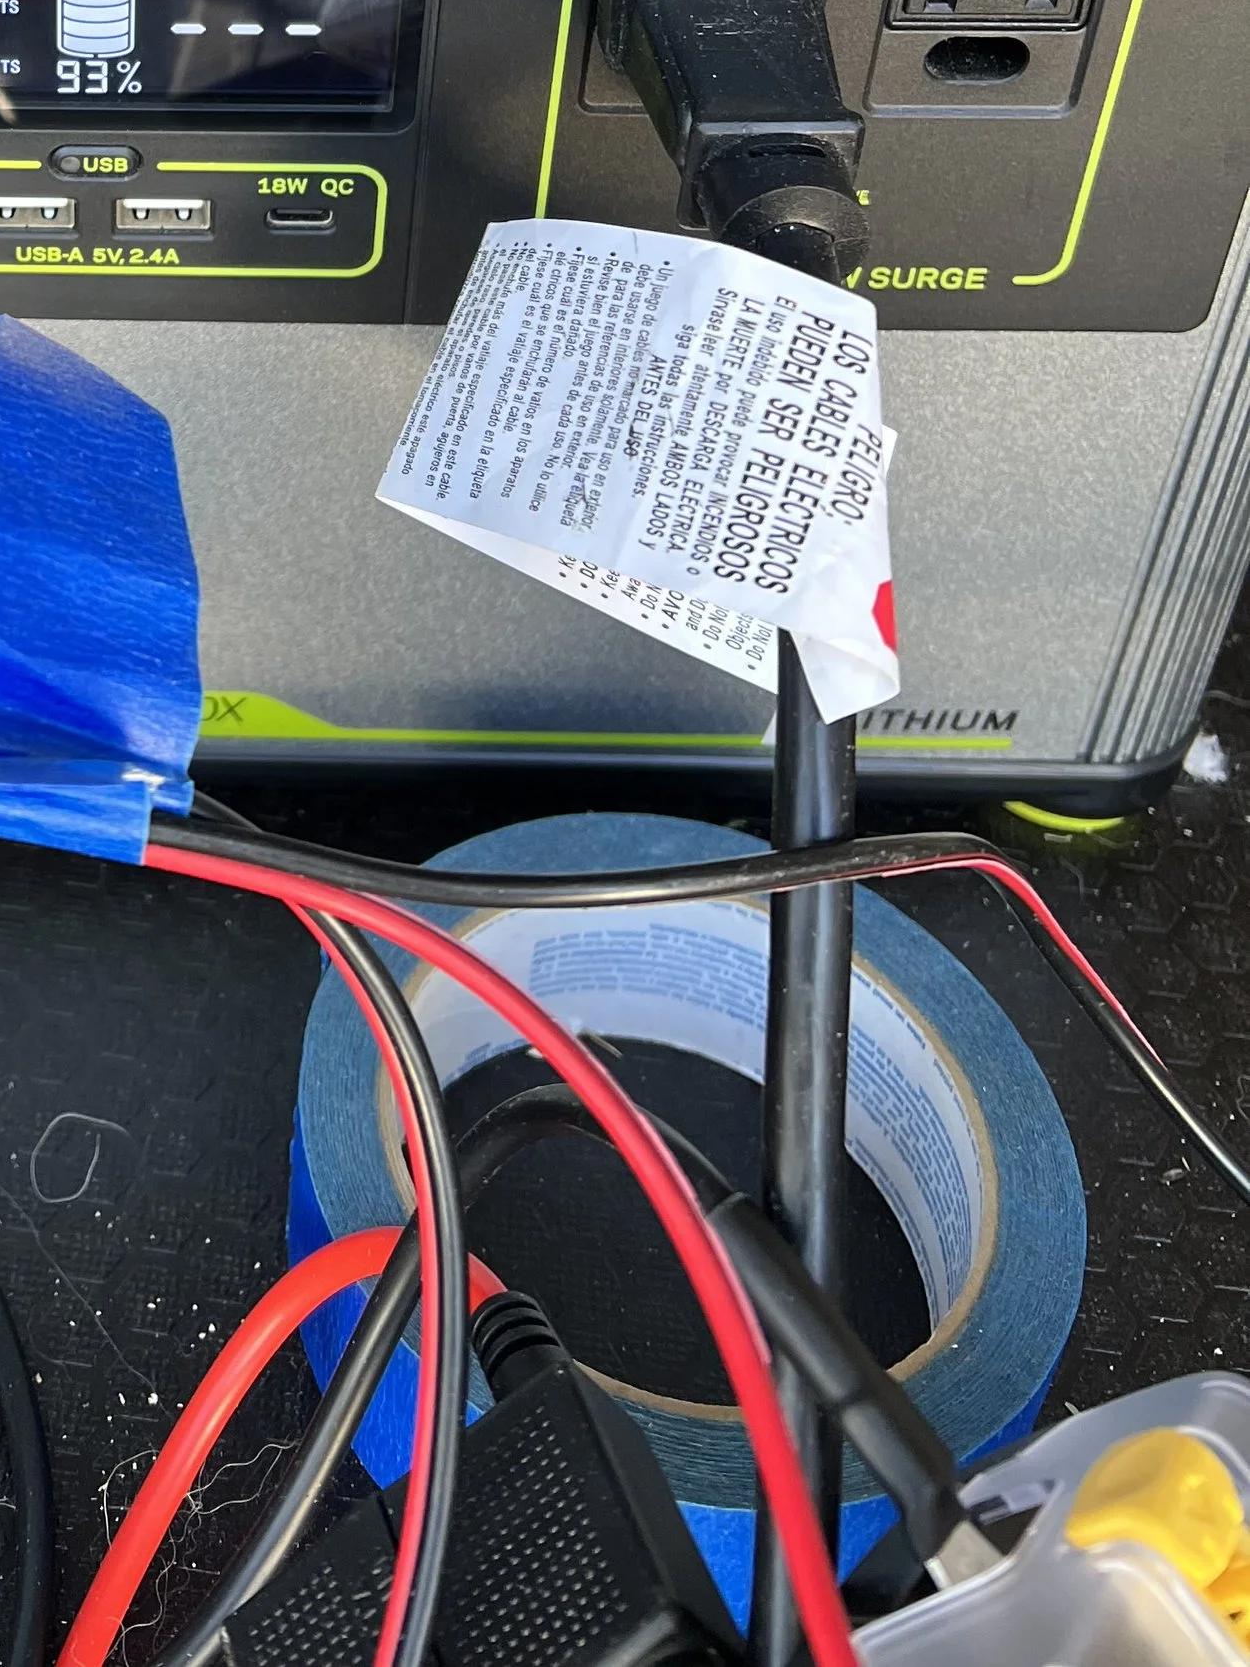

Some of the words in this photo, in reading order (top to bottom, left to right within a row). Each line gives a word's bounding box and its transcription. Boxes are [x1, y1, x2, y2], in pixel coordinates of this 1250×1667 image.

[57, 60, 143, 95] 93%
[83, 157, 128, 174] USB
[257, 177, 308, 195] 18W
[320, 178, 355, 197] QC
[16, 246, 85, 264] USB-A
[516, 248, 528, 261] No
[524, 247, 537, 262] del
[586, 255, 600, 265] si
[596, 258, 620, 291] Revise
[620, 261, 636, 273] de
[633, 263, 654, 288] debe
[655, 267, 674, 282] Un
[867, 266, 989, 290] SURGE
[544, 268, 562, 300] ctricos
[572, 267, 595, 315] estuviera
[611, 278, 628, 301] para
[591, 293, 609, 315] bien
[643, 281, 668, 311] juego
[740, 297, 765, 315] LA
[774, 295, 797, 312] El
[524, 305, 536, 317] es
[539, 303, 552, 321] que
[555, 309, 567, 321] es
[607, 303, 624, 319] las
[622, 291, 642, 325] usarse
[486, 322, 499, 338] del
[520, 319, 533, 330] el
[535, 324, 547, 336] se
[552, 324, 566, 337] el
[587, 317, 601, 329] el
[641, 313, 658, 327] de
[765, 311, 786, 333] uso
[578, 328, 600, 358] juego
[618, 327, 632, 341] en
[674, 324, 697, 349] siga
[699, 332, 723, 357] leer
[721, 317, 757, 370] MUERTE
[507, 332, 528, 363] vatiaje
[541, 336, 561, 373] número
[592, 321, 617, 377] referencias
[632, 329, 651, 363] cables
[776, 311, 835, 393] PUEDEN
[832, 329, 872, 374] LOS
[516, 339, 543, 392] enchufarán
[605, 343, 631, 391] interiores
[665, 354, 689, 387] todas
[745, 335, 782, 386] indebido
[535, 375, 550, 388] de
[571, 359, 589, 387] antes
[627, 365, 641, 380] no
[640, 354, 667, 396] ANTES
[714, 371, 733, 394] por
[487, 366, 515, 427] especificado
[566, 389, 582, 402] de
[588, 379, 604, 392] de
[455, 373, 481, 432] especificado
[512, 393, 525, 404] al
[524, 391, 543, 419] vatios
[579, 394, 596, 413] uso
[613, 380, 636, 424] marcado
[657, 391, 679, 410] las
[673, 363, 711, 437] atentamente
[731, 388, 756, 427] puede
[557, 404, 573, 428] cada
[575, 414, 588, 428] en
[584, 393, 614, 446] solamente.
[631, 400, 653, 424] DEL
[757, 398, 803, 441] SER
[801, 378, 857, 457] CABLES
[483, 429, 495, 443] en
[520, 422, 532, 435] en
[604, 425, 622, 450] para
[689, 401, 728, 471] DESCARGA
[451, 434, 462, 447] en
[479, 444, 494, 455] la
[515, 437, 532, 453] los
[623, 427, 644, 457] USO
[444, 448, 457, 470] este
[544, 454, 560, 468] No
[577, 451, 598, 470] Vea
[597, 451, 613, 471] uso
[631, 414, 666, 497] instrucciones.
[659, 440, 689, 488] AMBOS
[713, 430, 742, 488] provocar
[435, 472, 451, 500] cable.
[469, 457, 489, 499] etiqueta
[500, 455, 524, 498] aparatos
[539, 470, 554, 480] lo
[573, 471, 590, 484] la
[592, 473, 606, 487] en
[826, 424, 882, 525] PELIGRO:
[528, 482, 547, 512] utilice
[559, 484, 584, 527] etiqueta
[646, 492, 674, 537] LADOS
[713, 448, 785, 582] PELIGROSOS
[690, 491, 728, 563] INCENDIOS
[754, 462, 828, 593] ELÉCTRICOS
[638, 538, 656, 550] y
[686, 566, 700, 575] o
[661, 589, 685, 621] AVO
[685, 612, 703, 631] and
[702, 624, 721, 641] Do
[752, 624, 774, 645] Not
[745, 644, 764, 661] Do
[861, 708, 1020, 731] ITHIUM
